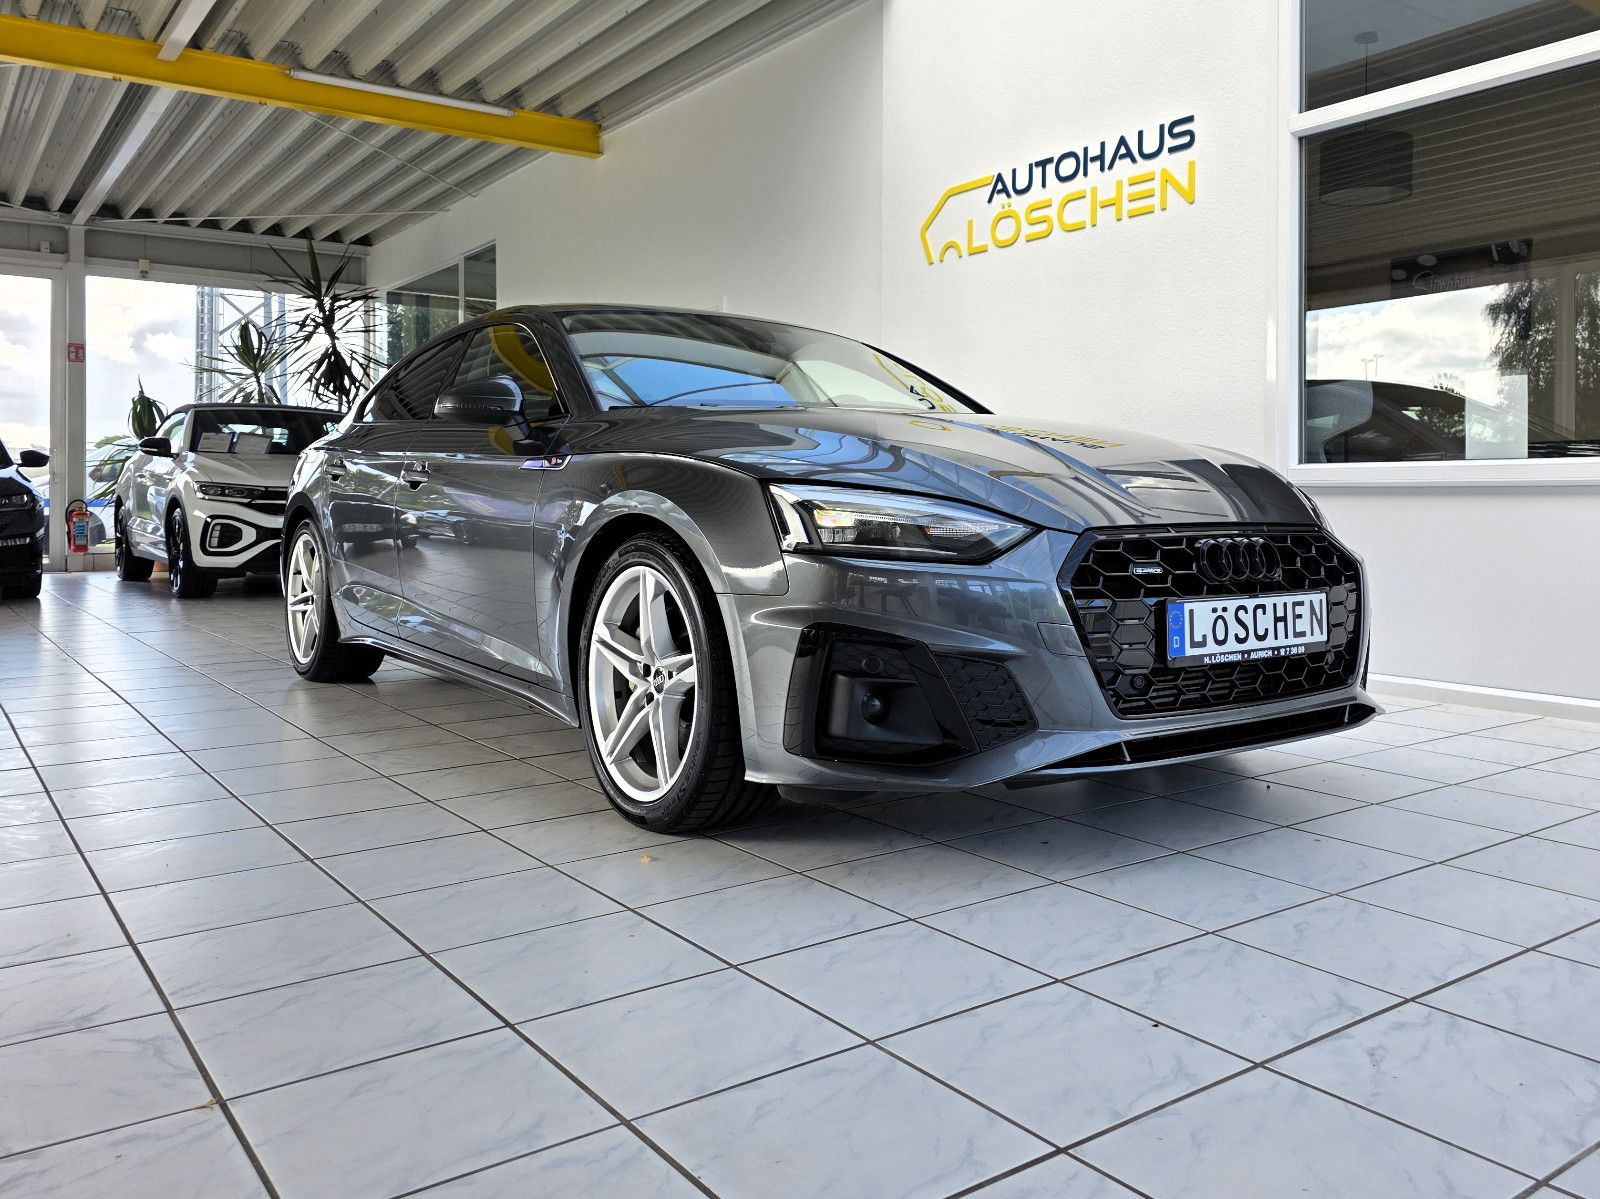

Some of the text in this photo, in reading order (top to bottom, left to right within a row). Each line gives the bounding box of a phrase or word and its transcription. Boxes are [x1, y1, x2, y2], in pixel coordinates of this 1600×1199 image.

[987, 114, 1196, 204] AUTOHAUS
[967, 160, 1196, 256] LÖSCHEN
[1173, 636, 1180, 648] D
[1188, 598, 1324, 649] LÖSCHEN
[1249, 649, 1273, 660] AURICH
